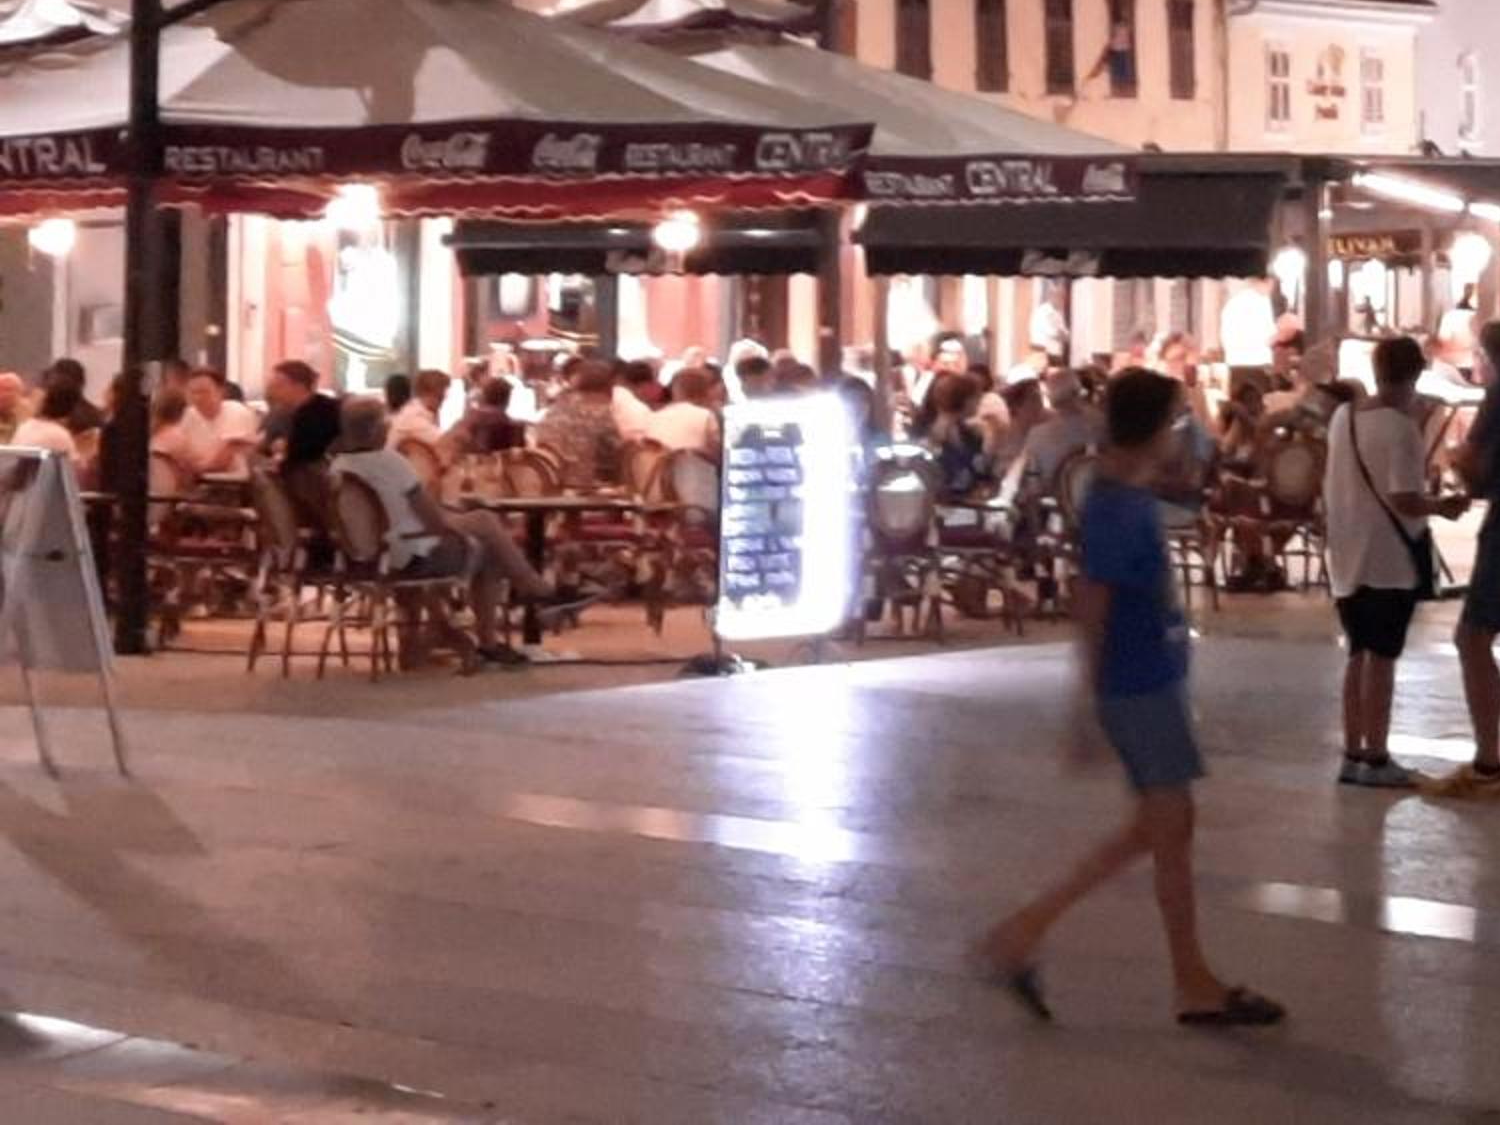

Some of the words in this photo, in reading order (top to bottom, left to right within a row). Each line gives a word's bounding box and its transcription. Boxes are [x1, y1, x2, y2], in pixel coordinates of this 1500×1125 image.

[164, 145, 324, 172] RESTAURANT
[401, 133, 491, 169] Coca-Cola
[965, 161, 1058, 194] CENTRAL
